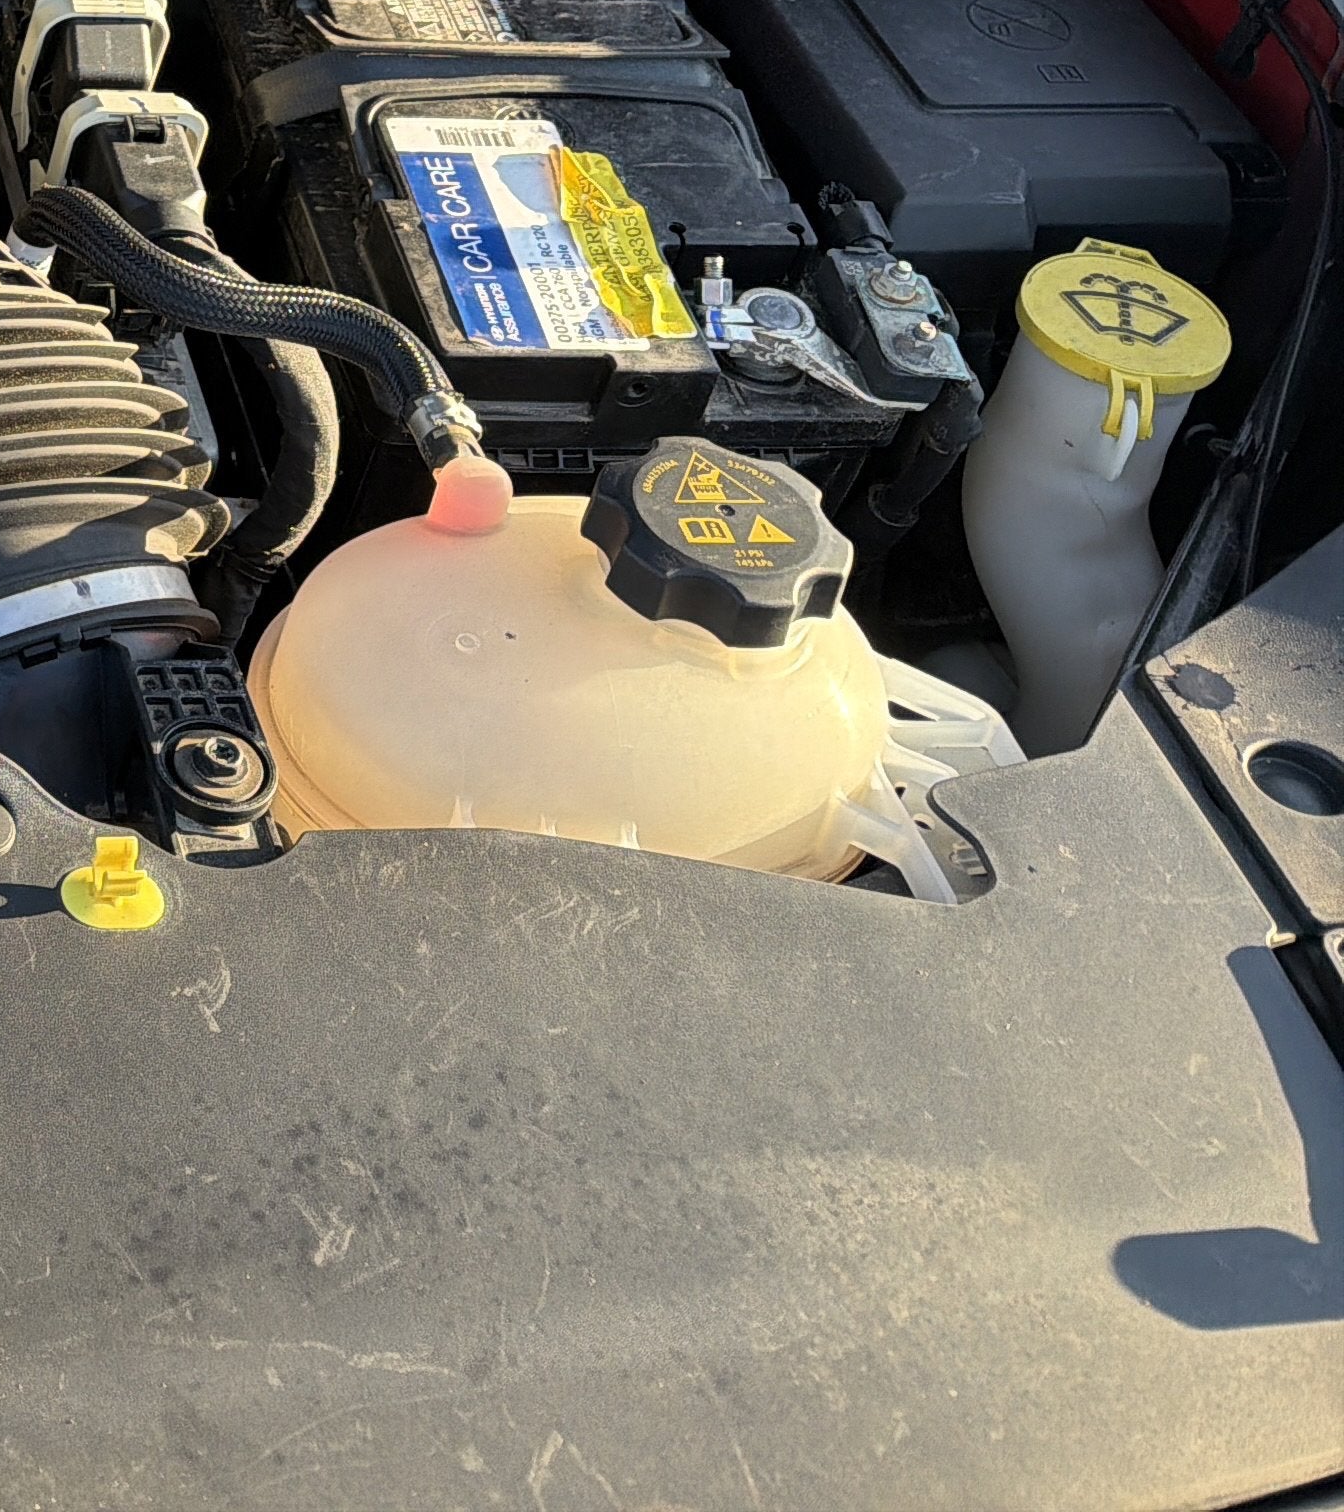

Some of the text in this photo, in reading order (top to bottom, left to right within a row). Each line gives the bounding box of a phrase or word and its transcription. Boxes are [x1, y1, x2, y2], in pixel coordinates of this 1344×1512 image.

[424, 156, 493, 273] CAR CARE
[530, 225, 547, 241] 120
[537, 242, 554, 258] RC
[474, 283, 499, 324] HYUNDAI
[489, 282, 522, 342] Assurance
[557, 288, 576, 310] CCA
